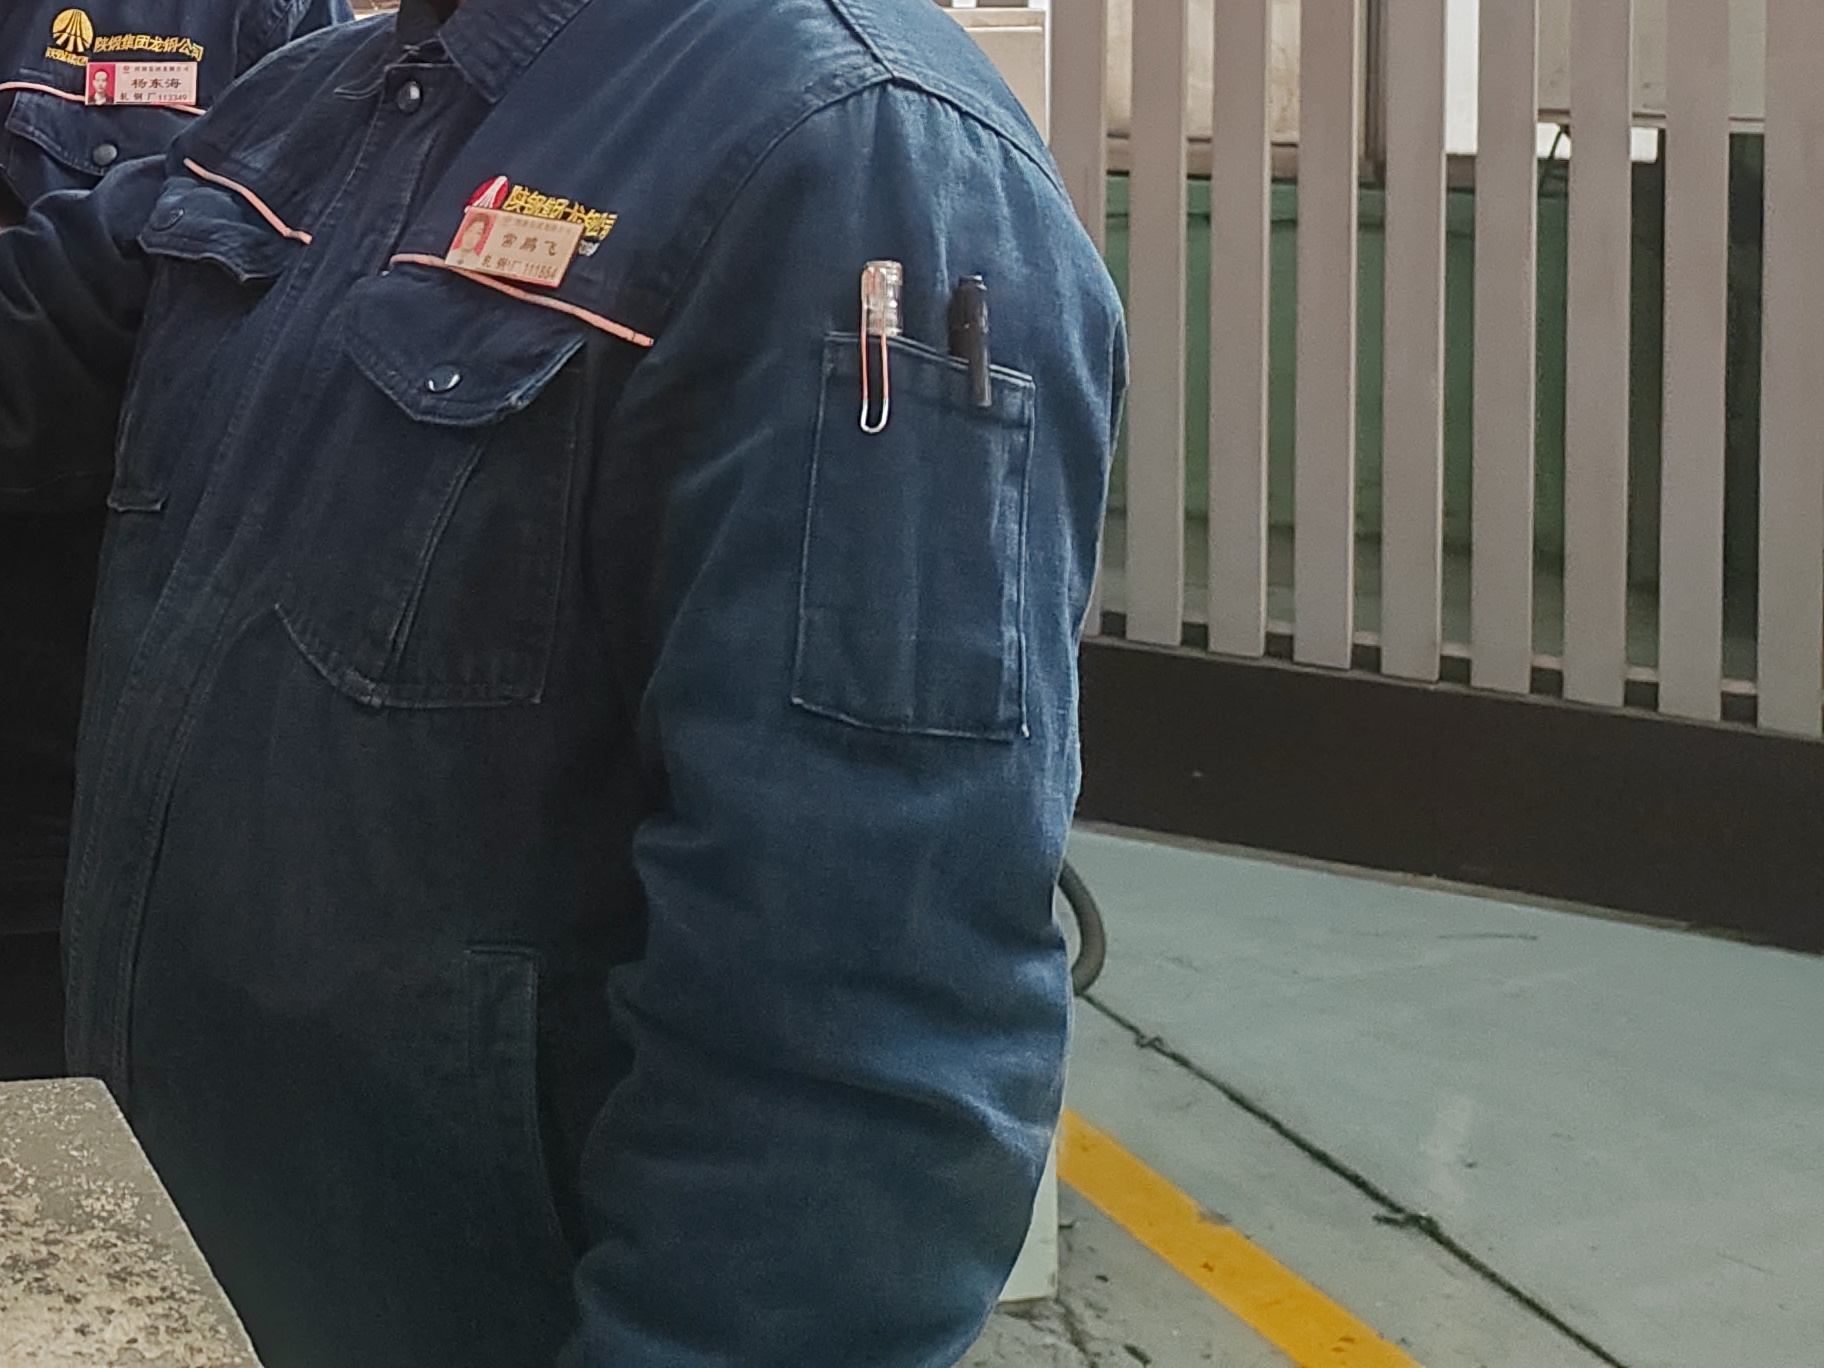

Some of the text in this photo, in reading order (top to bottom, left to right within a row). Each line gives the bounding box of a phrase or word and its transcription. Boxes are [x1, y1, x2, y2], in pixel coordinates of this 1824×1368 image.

[93, 34, 205, 62] 陕钢集团龙钢公司
[131, 78, 183, 89] 杨东海
